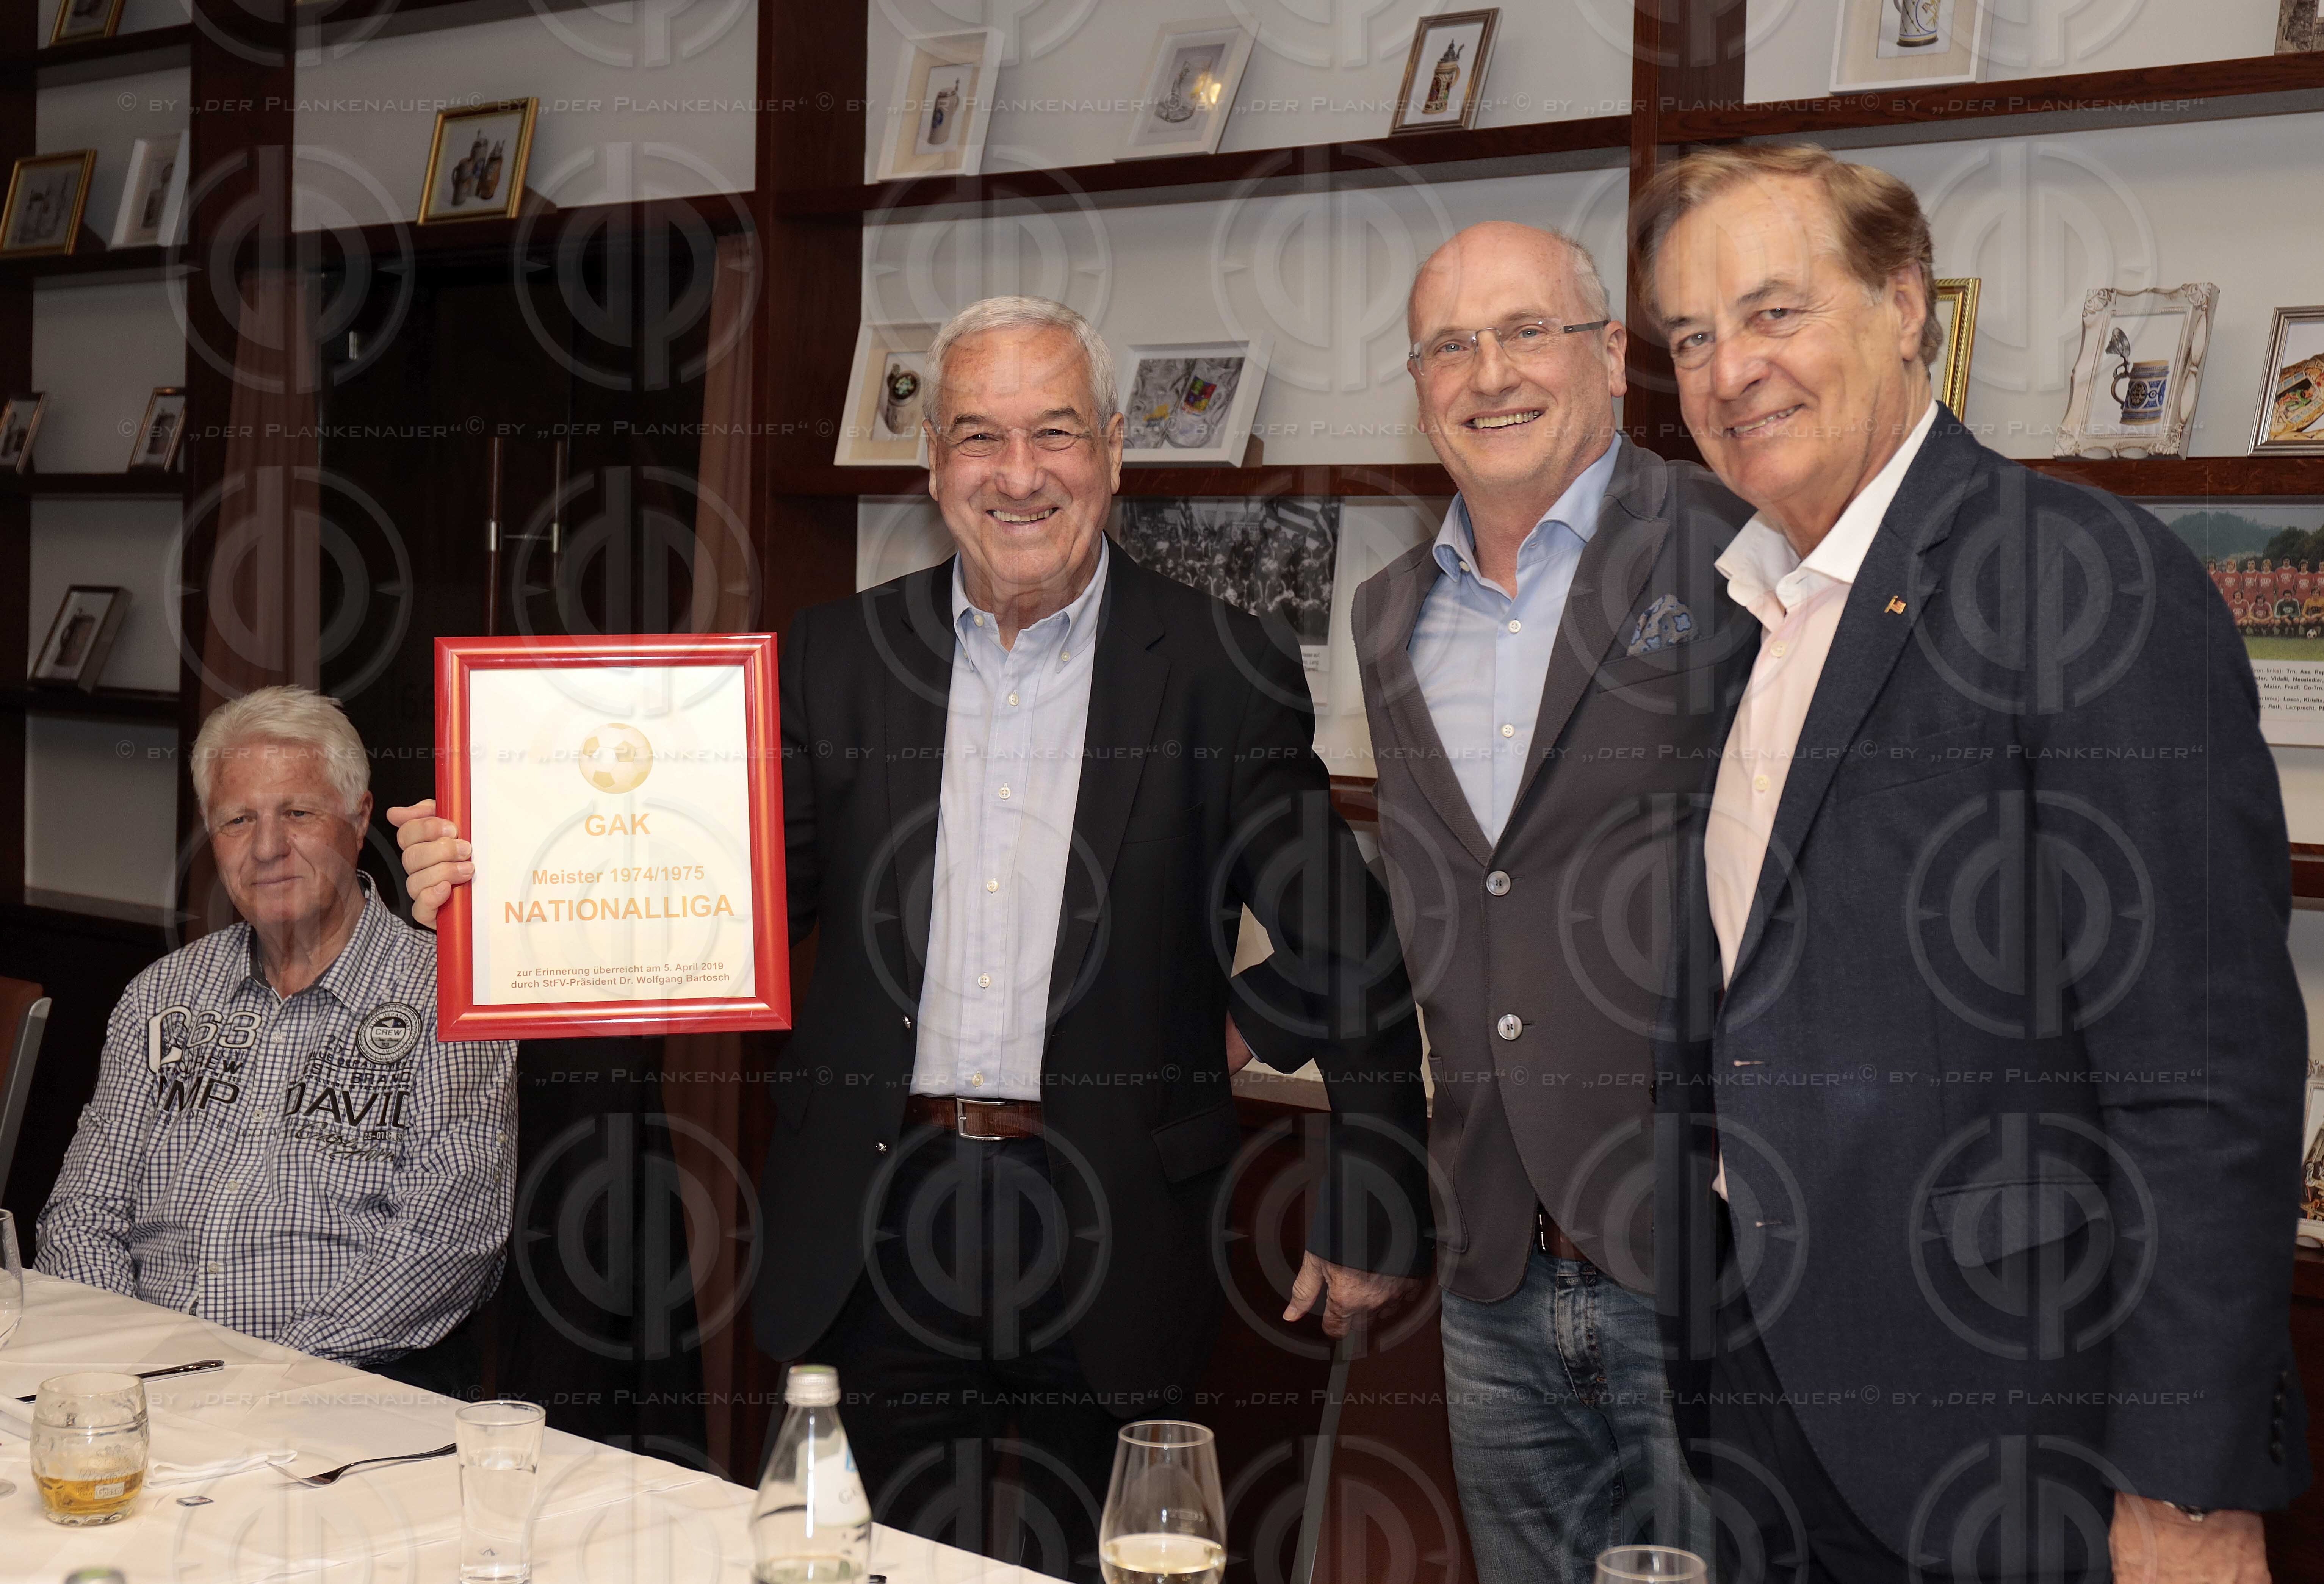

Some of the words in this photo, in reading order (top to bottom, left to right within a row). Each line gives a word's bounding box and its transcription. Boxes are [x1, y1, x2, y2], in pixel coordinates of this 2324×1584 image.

[585, 813, 651, 837] GAK
[532, 869, 604, 885] Meister
[610, 866, 705, 883] 1974/1975
[504, 895, 734, 923] NATIONALLIGA
[536, 968, 590, 977] Erinnerung
[593, 965, 644, 974] überreicht
[675, 963, 698, 973] April
[701, 962, 724, 970] 2019
[511, 980, 539, 989] durch
[543, 978, 617, 988] StFV-Präsident
[636, 975, 683, 985] Wolfgang
[686, 973, 730, 982] Bartosch
[350, 1072, 412, 1085] BRAND
